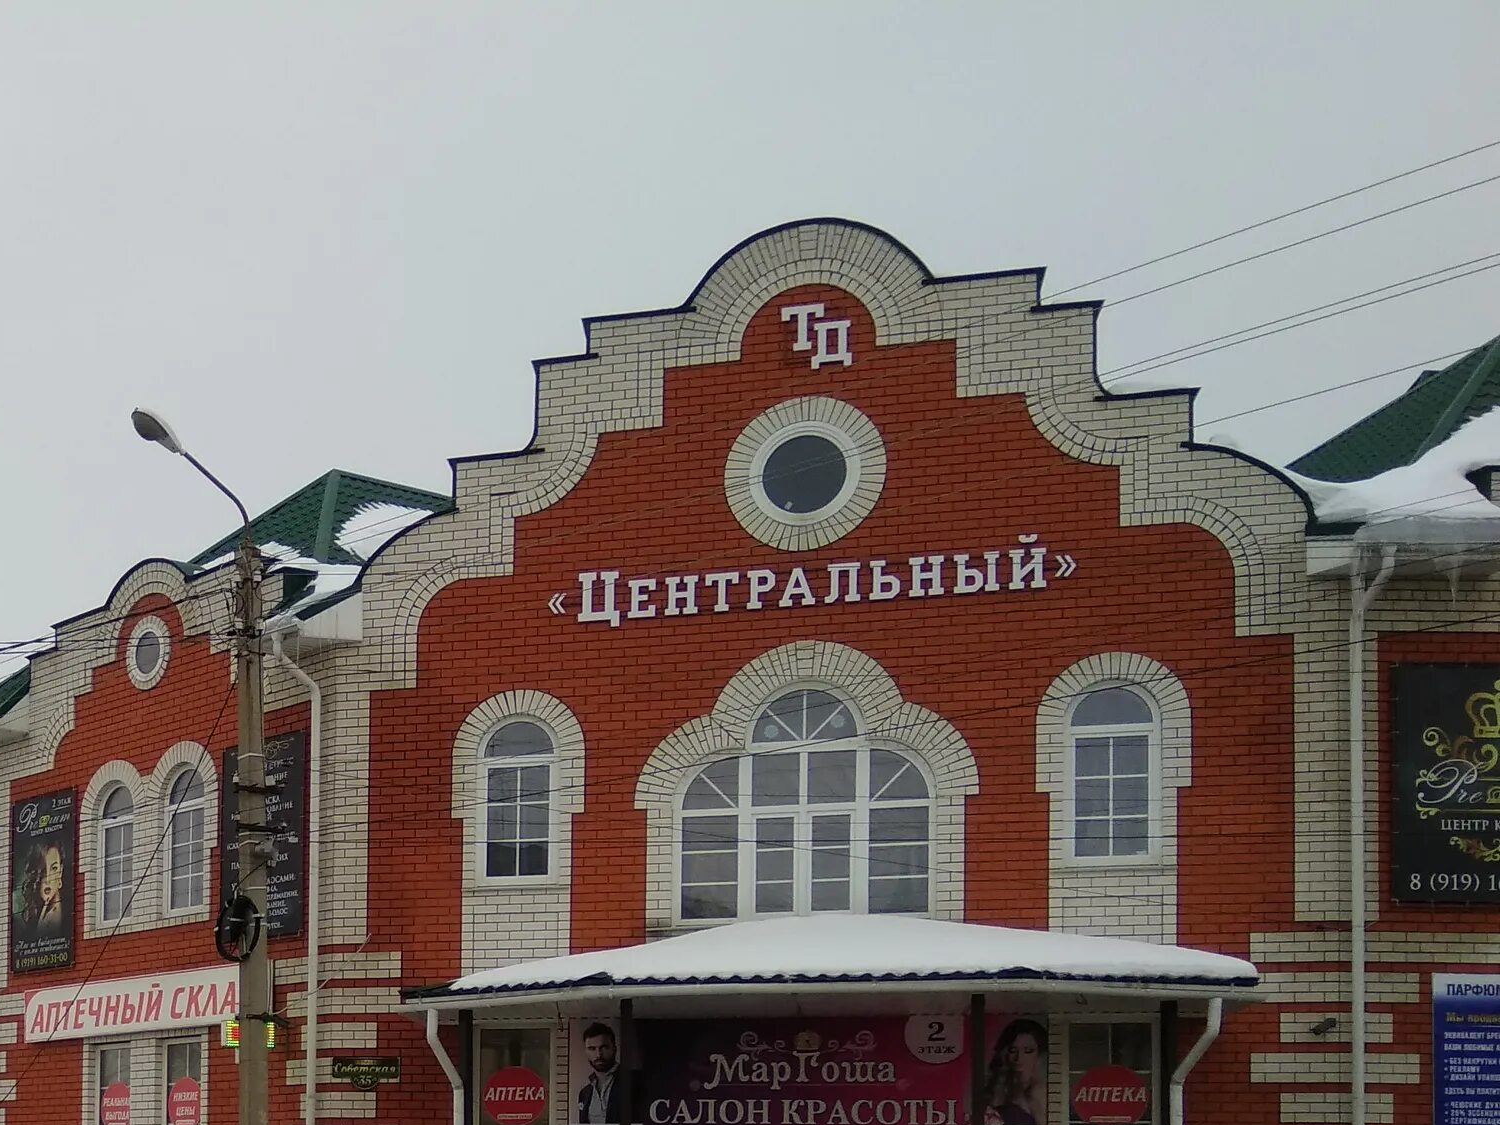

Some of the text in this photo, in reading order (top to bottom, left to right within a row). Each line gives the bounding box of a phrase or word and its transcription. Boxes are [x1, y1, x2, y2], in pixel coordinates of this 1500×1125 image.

[781, 303, 852, 369] ТД
[1441, 819, 1489, 832] ЦЕНТР
[1410, 873, 1421, 891] 8
[1430, 873, 1480, 892] (919)
[30, 980, 239, 1034] АПТЕЧНЫЙ СКЛА
[927, 1021, 946, 1042] 2
[917, 1044, 956, 1055] этаж
[334, 1062, 396, 1073] Советская
[703, 1050, 897, 1090] МарГоша
[358, 1075, 372, 1086] 35
[484, 1086, 545, 1101] АПТЕКА
[1075, 1087, 1146, 1102] АПТЕКА
[103, 1097, 131, 1107] РЕАЛЬНА
[176, 1106, 196, 1117] ЦЕНЫ
[649, 1099, 772, 1125] САЛОН
